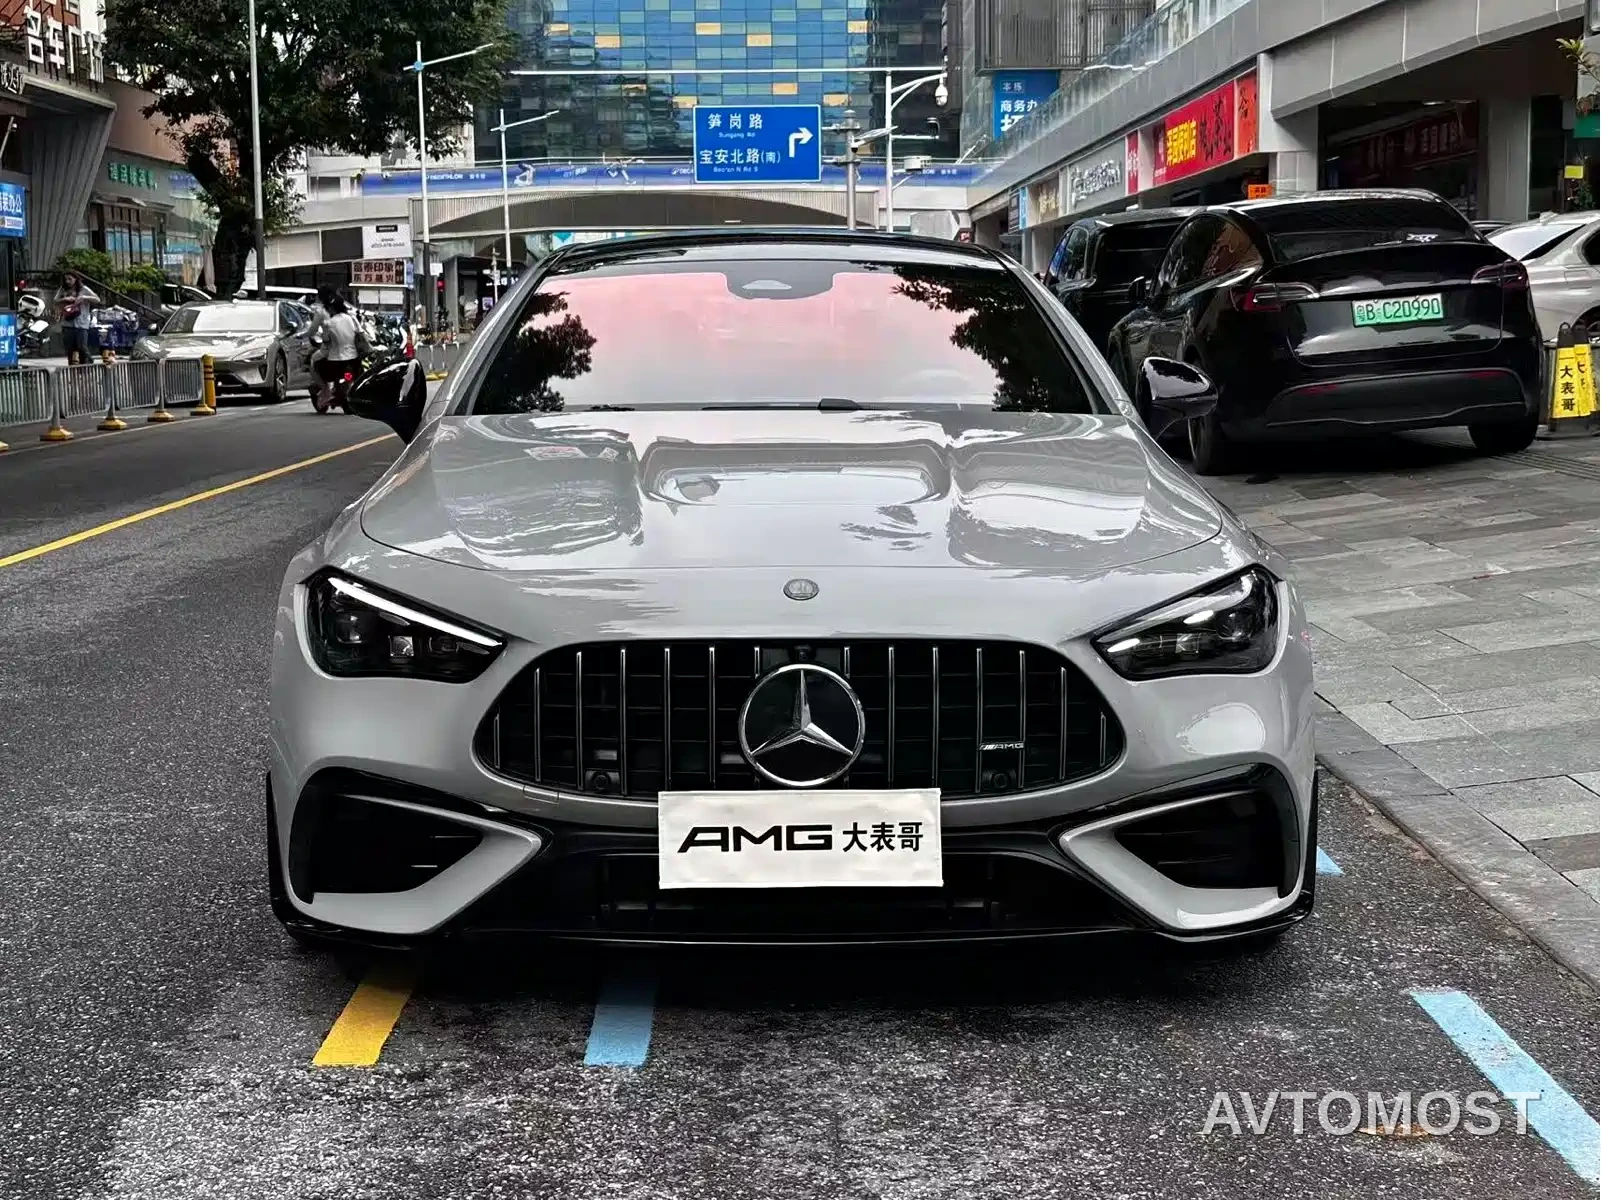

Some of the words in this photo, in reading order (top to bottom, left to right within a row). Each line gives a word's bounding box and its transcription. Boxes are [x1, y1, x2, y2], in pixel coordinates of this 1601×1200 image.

[707, 113, 763, 130] 笋岗路
[699, 148, 781, 164] 宝安北路(南)
[1559, 364, 1576, 412] 大表哥
[677, 824, 833, 854] AMG
[842, 822, 924, 853] 大表哥
